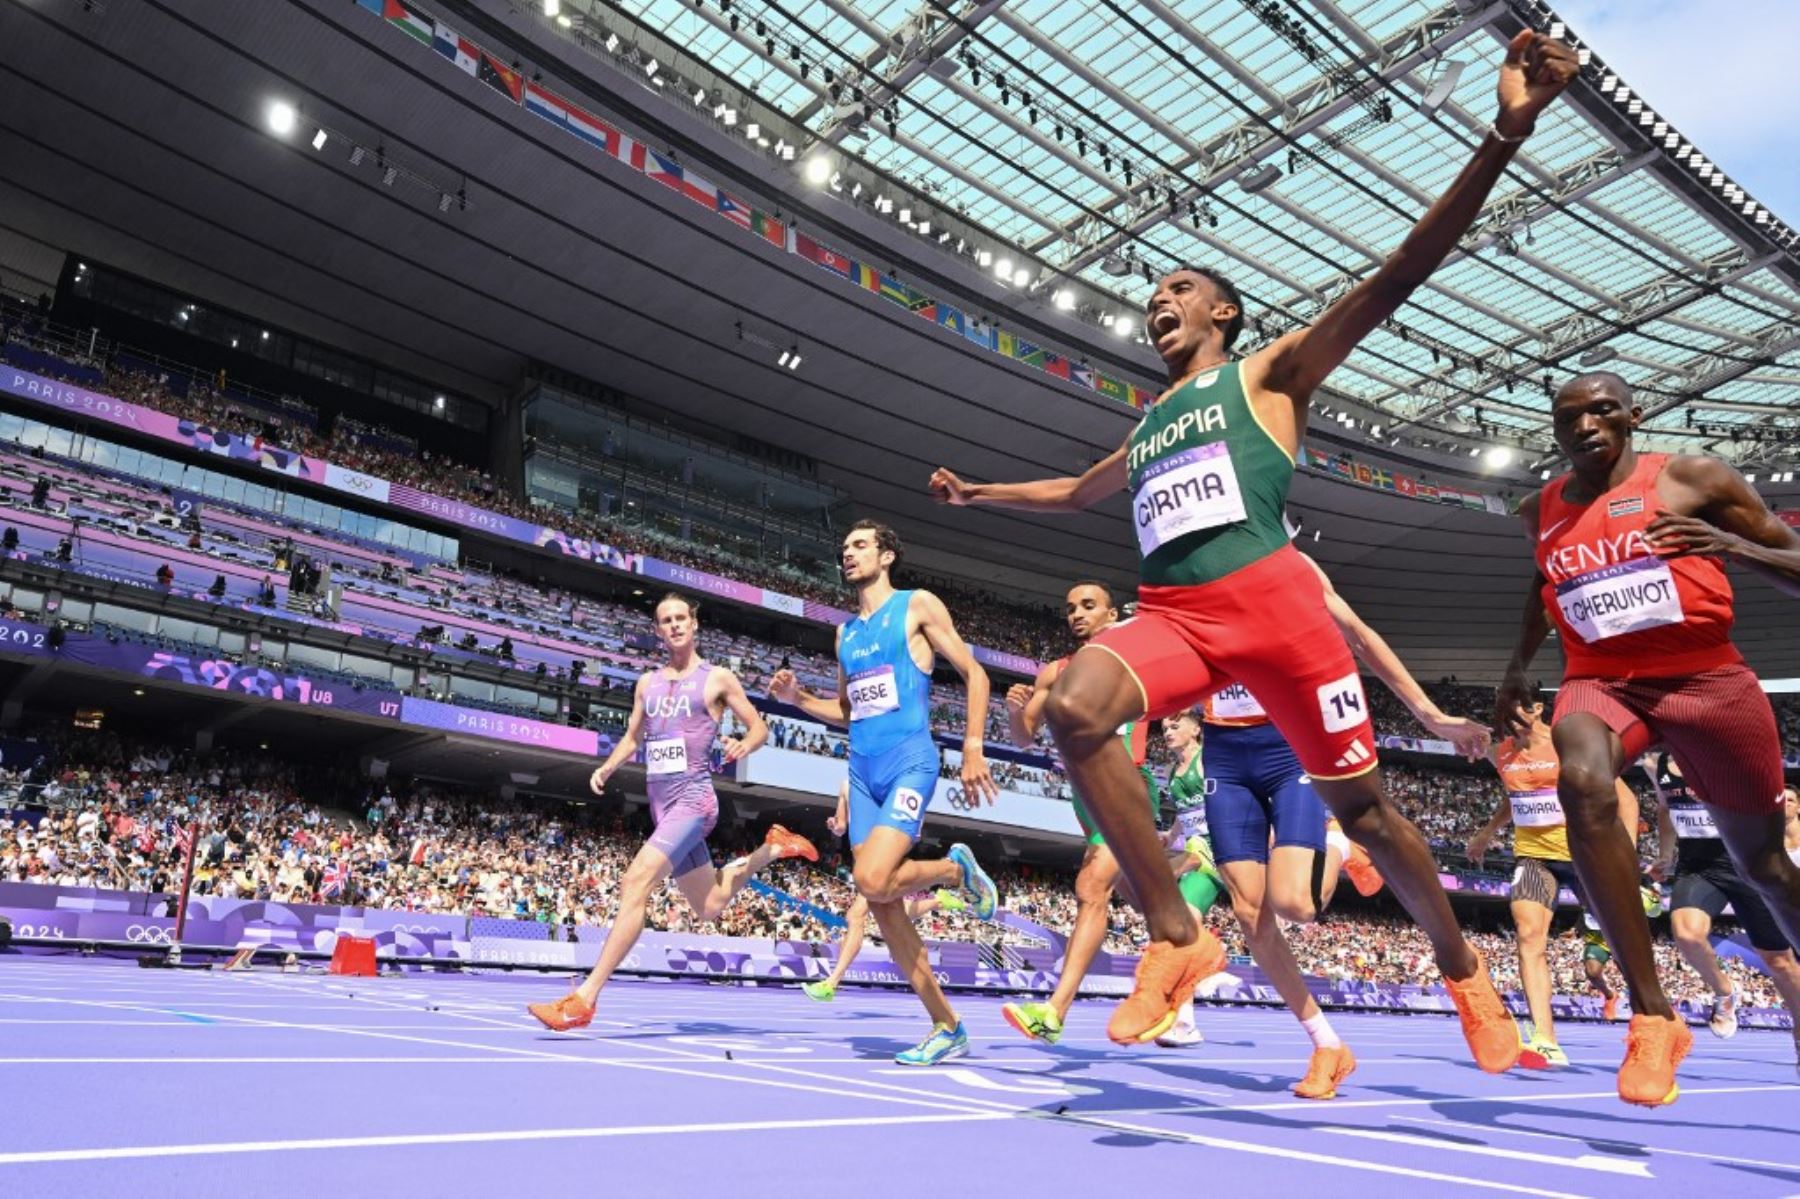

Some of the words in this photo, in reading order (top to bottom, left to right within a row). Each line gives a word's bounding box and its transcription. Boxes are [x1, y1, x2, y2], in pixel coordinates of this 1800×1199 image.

[13, 375, 75, 403] PARIS
[84, 396, 136, 421] 2024
[1127, 404, 1227, 472] THIOPIA
[177, 500, 192, 517] 2
[1139, 472, 1225, 527] GIRMA
[421, 498, 465, 519] PARIS
[469, 511, 507, 530] 2024
[1546, 530, 1653, 584] KENYA
[670, 568, 705, 586] PARIS
[1573, 579, 1671, 622] CHERUIYOT
[312, 689, 333, 704] U8
[380, 702, 399, 716] U7
[646, 695, 692, 718] USA
[1330, 690, 1361, 719] 14
[457, 713, 504, 732] PARIS
[510, 723, 550, 740] 2024
[900, 794, 918, 811] 10
[480, 950, 526, 963] PARIS
[844, 968, 869, 979] ARIS
